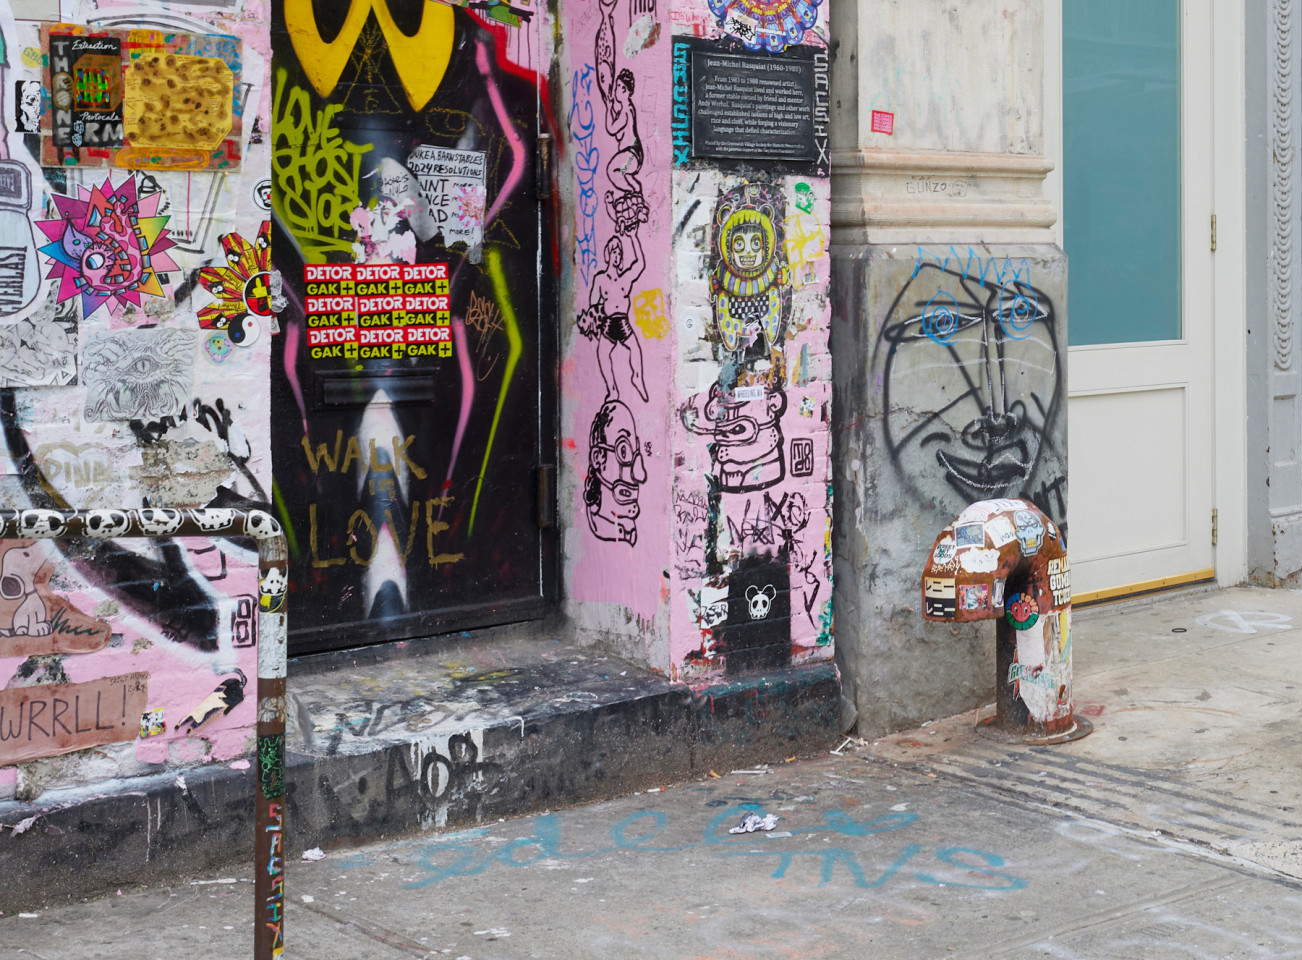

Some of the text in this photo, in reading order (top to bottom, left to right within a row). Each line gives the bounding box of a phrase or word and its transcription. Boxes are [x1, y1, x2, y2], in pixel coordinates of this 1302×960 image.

[708, 59, 741, 68] Jean-Michel
[742, 61, 766, 70] Basquiat
[734, 85, 753, 93] Basquiat
[757, 94, 762, 102] by
[756, 103, 776, 111] paintings
[434, 164, 482, 176] RESOLUTIONS
[306, 266, 352, 280] DETOR
[356, 265, 400, 280] DETOR
[404, 265, 446, 280] DETOR
[307, 283, 338, 295] GAK
[357, 282, 387, 295] GAK
[404, 282, 433, 294] GAK
[308, 297, 353, 312] DETOR
[360, 296, 403, 312] DETOR
[405, 296, 448, 311] DETOR
[308, 315, 339, 327] GAK
[360, 313, 390, 327] GAK
[405, 313, 435, 325] GAK
[310, 327, 355, 344] DETOR
[360, 328, 403, 344] DETOR
[408, 327, 449, 341] DETOR
[311, 346, 342, 359] GAK
[360, 346, 390, 358] GAK
[407, 344, 436, 356] GAK
[302, 429, 427, 482] WALK
[309, 496, 465, 570] LOVE
